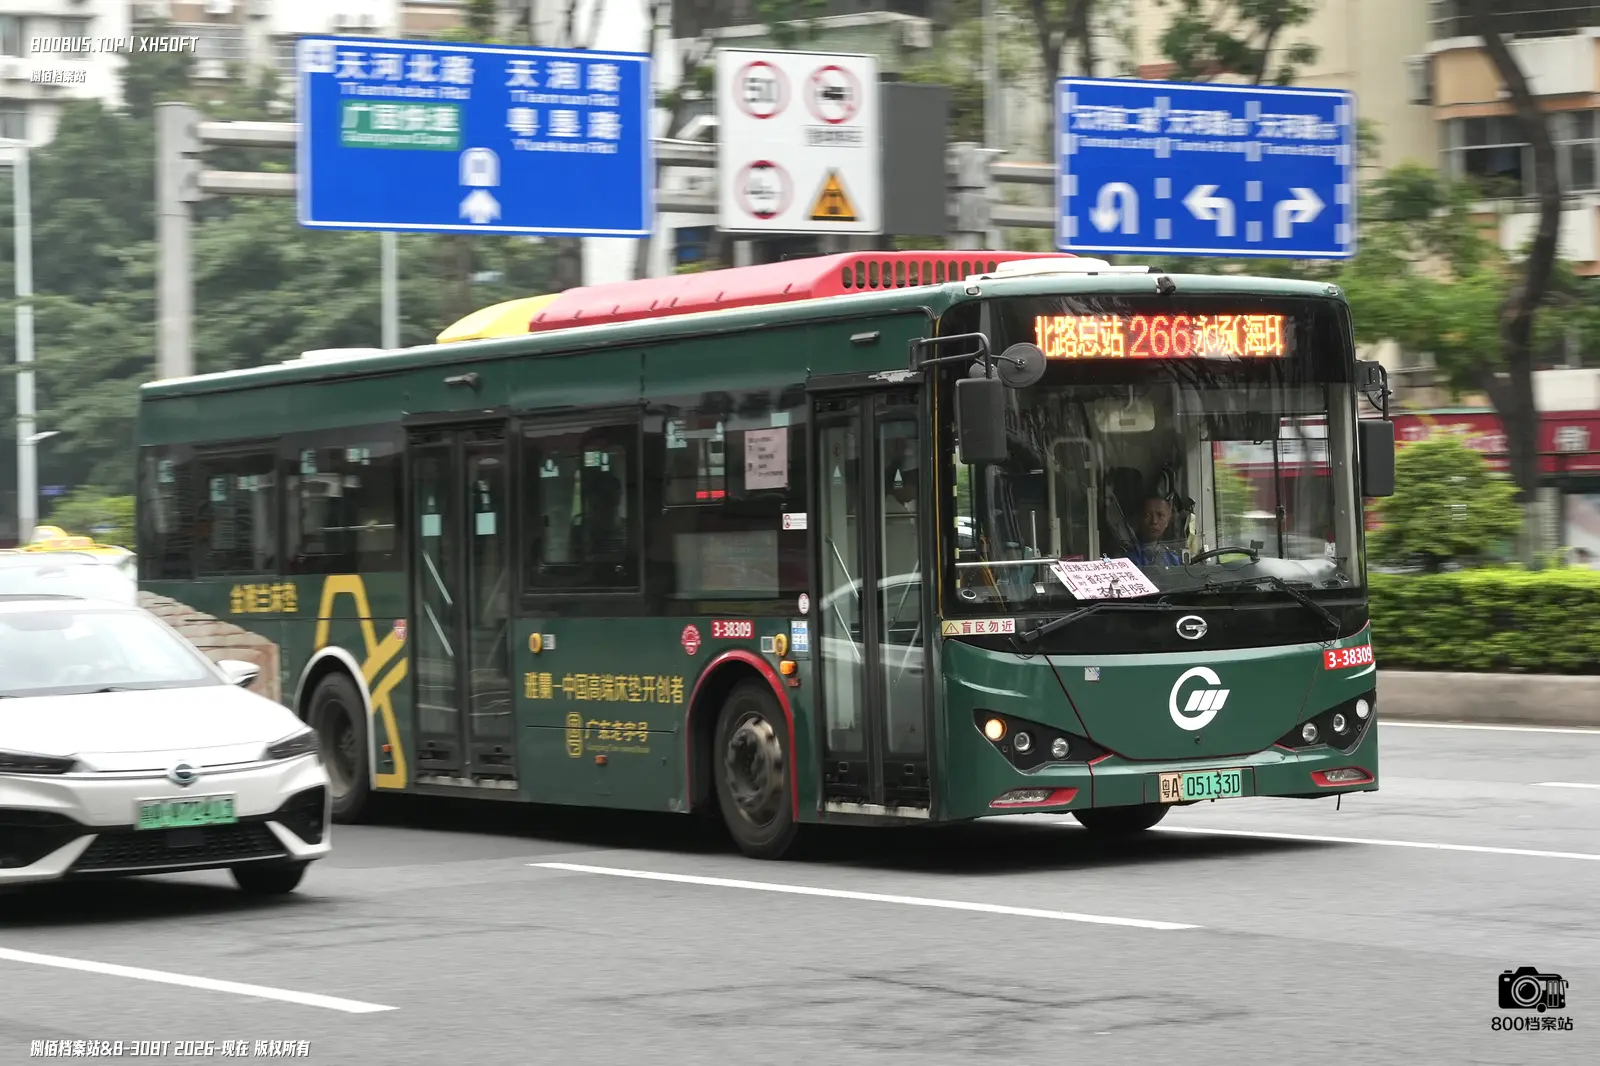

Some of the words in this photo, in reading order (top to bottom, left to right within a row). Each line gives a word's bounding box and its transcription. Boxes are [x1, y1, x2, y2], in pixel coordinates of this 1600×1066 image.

[334, 51, 475, 85] 天河北路
[1129, 315, 1191, 357] 266
[713, 621, 751, 637] 3-38309
[961, 620, 1013, 634] 盲区勿近
[1328, 646, 1373, 668] 3-38309
